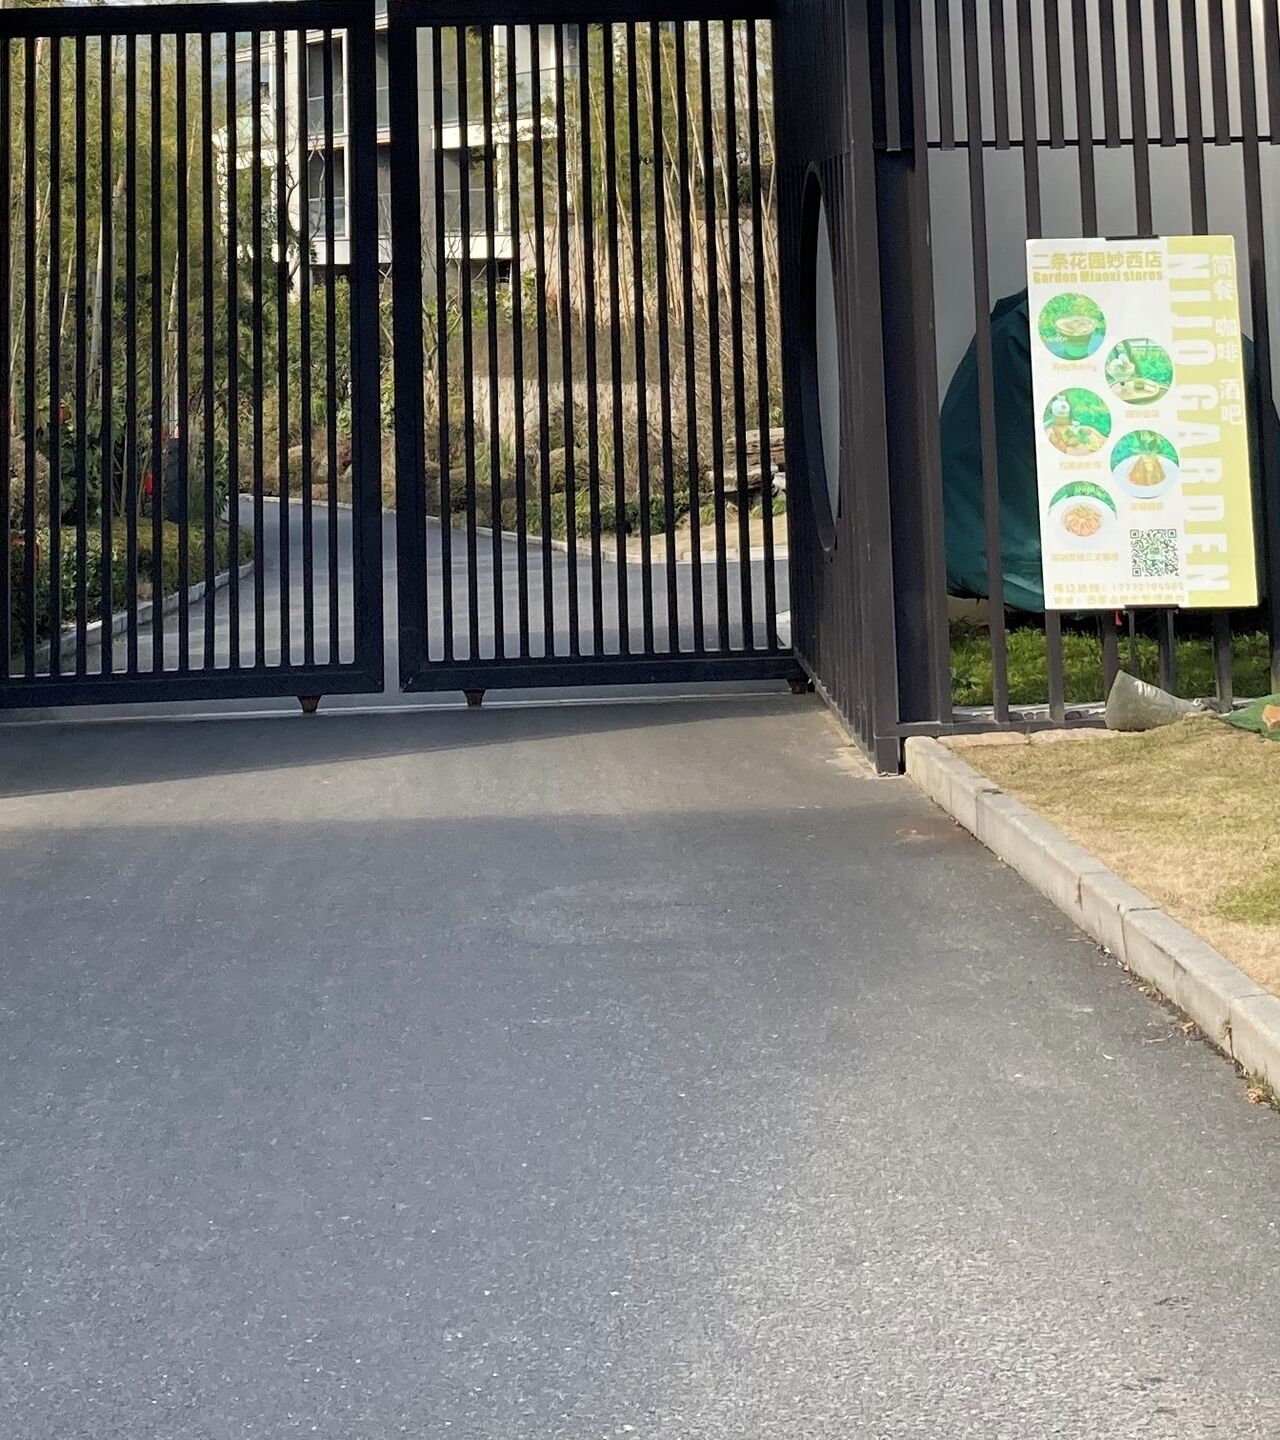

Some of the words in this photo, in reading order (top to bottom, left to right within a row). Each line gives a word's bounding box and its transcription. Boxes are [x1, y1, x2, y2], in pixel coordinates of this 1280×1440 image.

[1032, 250, 1163, 270] 二条花园妙西店
[1032, 270, 1078, 285] Garden
[1123, 270, 1163, 282] stores
[1215, 318, 1239, 363] 咖啡
[1220, 378, 1244, 425] 酒吧
[1174, 383, 1231, 592] GARDEN
